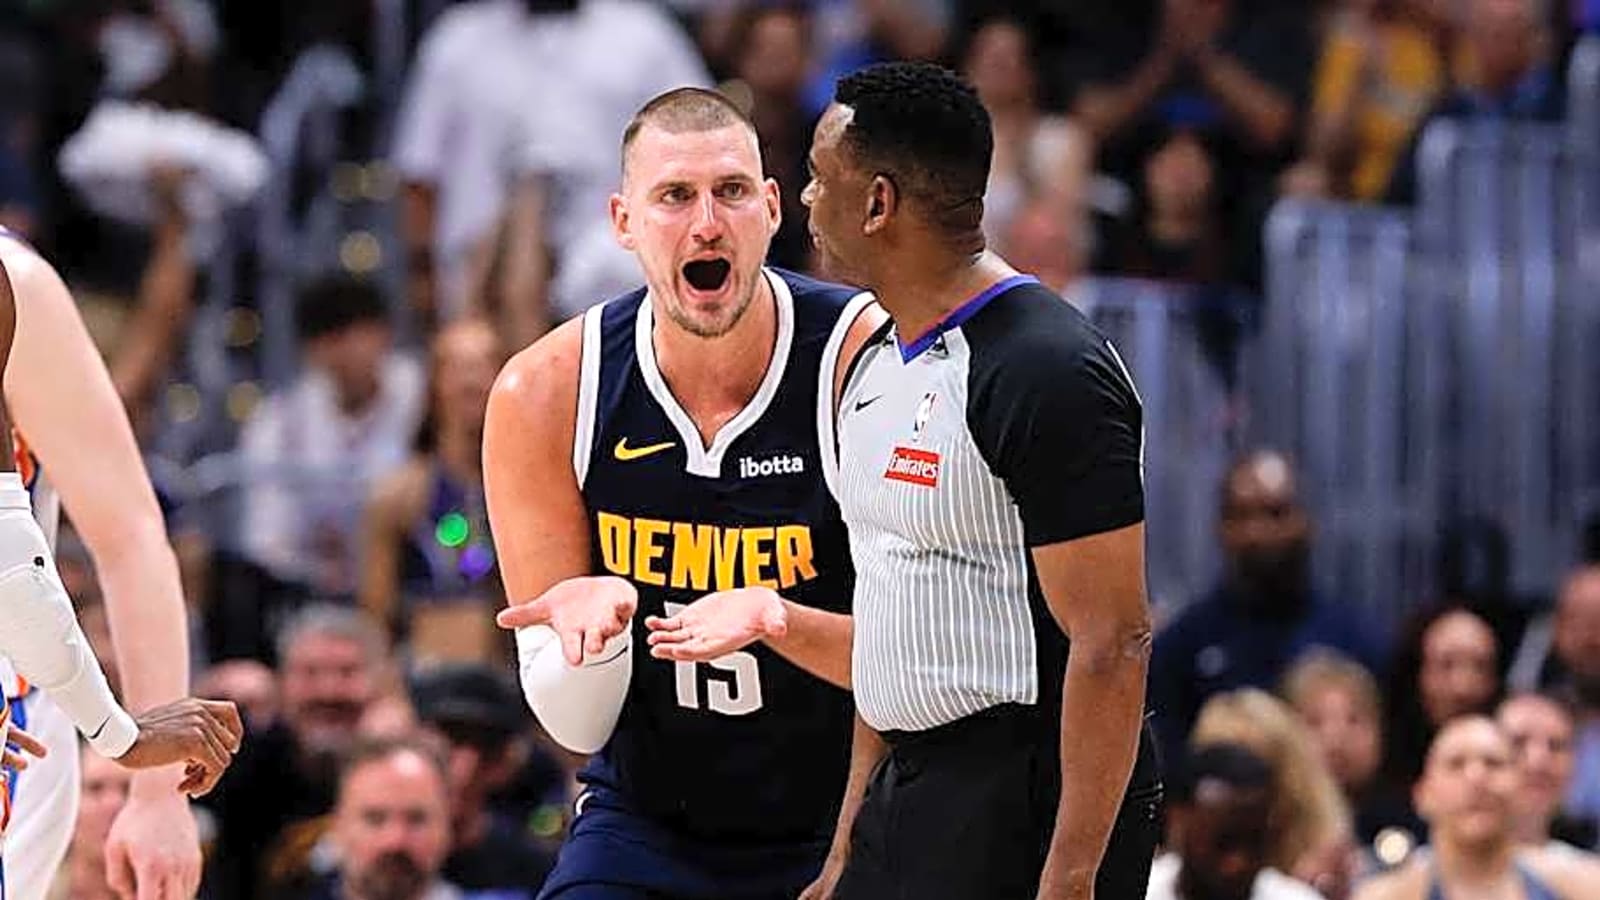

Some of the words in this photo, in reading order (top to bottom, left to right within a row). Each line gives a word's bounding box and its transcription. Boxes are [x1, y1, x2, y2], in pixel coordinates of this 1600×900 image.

[739, 455, 804, 478] ibotta
[889, 453, 938, 478] Emirates
[597, 511, 818, 592] DENVER
